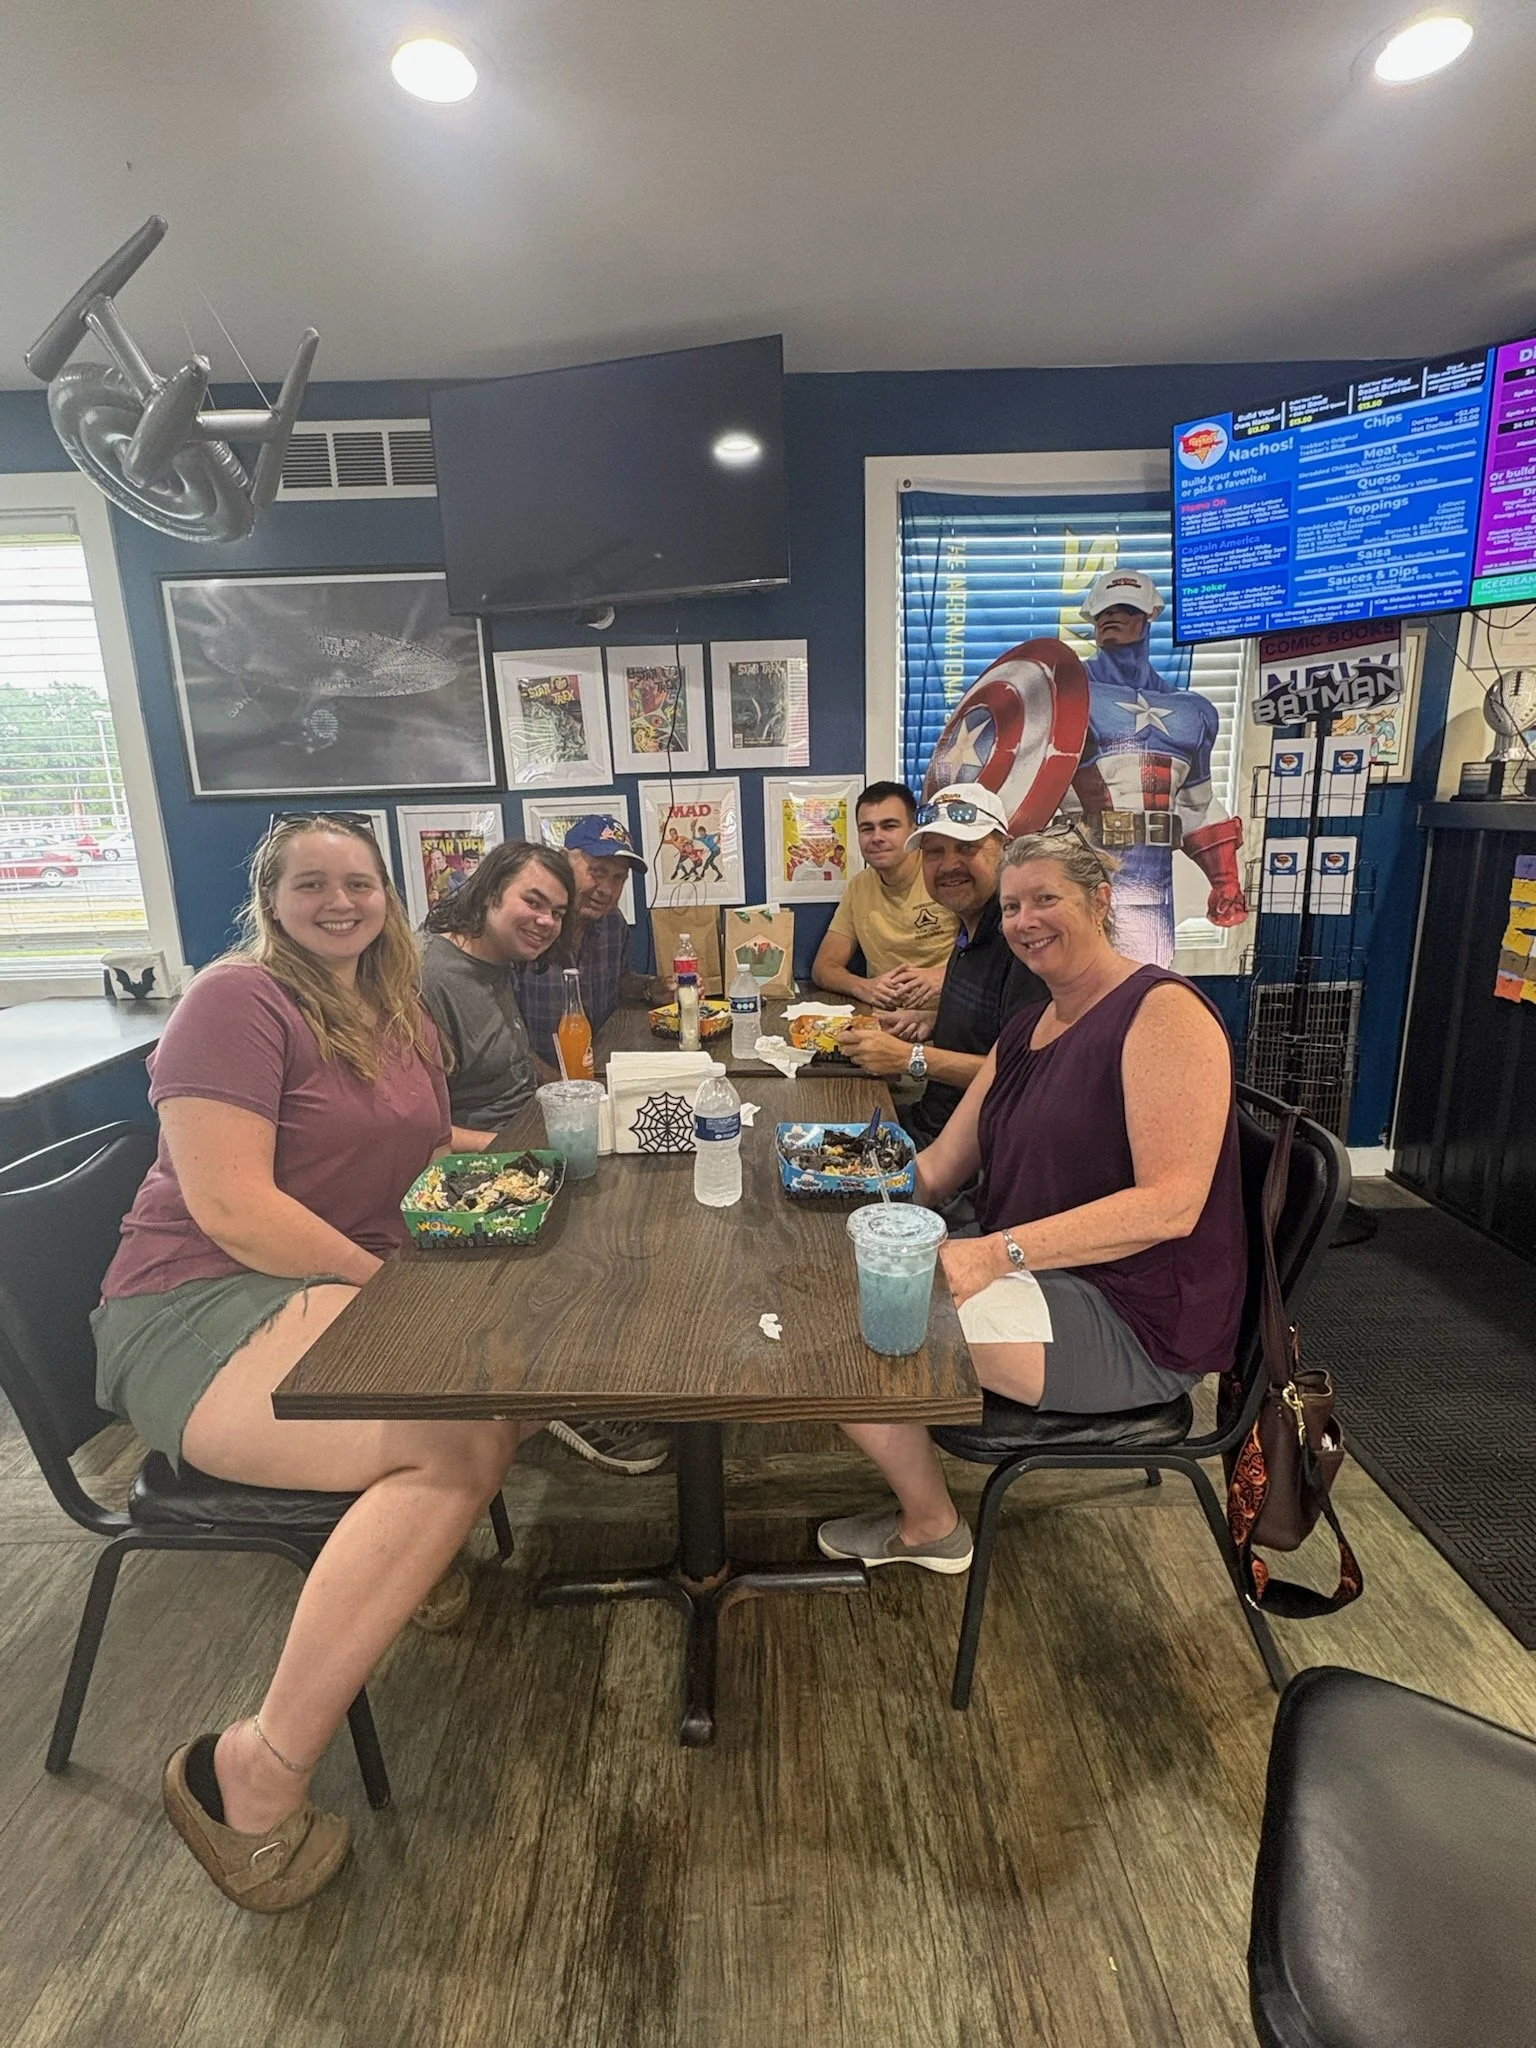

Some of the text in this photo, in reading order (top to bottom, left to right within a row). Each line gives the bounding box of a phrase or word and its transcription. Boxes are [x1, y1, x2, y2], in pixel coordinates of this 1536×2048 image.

[1363, 413, 1402, 429] Chips
[1228, 437, 1294, 462] Nachos!
[1364, 444, 1397, 459] Meat
[1181, 467, 1258, 489] Build your own,
[1181, 488, 1191, 498] or
[1193, 484, 1215, 497] pick
[1225, 473, 1266, 489] favorite!
[1357, 474, 1401, 489] Queso
[1346, 497, 1408, 515] Toppings
[1181, 535, 1260, 555] Captain America
[1357, 548, 1391, 560] Salsa
[1328, 564, 1418, 586] Sauces & Dips
[1182, 584, 1227, 595] The Joker
[1266, 622, 1394, 655] COMIC BOOKS
[738, 660, 782, 678] STAR TREK
[528, 683, 550, 699] STAR
[552, 689, 575, 705] TREK
[1254, 668, 1402, 723] BATMAN
[669, 804, 712, 818] MAD
[421, 839, 455, 856] STAR
[416, 1220, 463, 1238] WOW!
